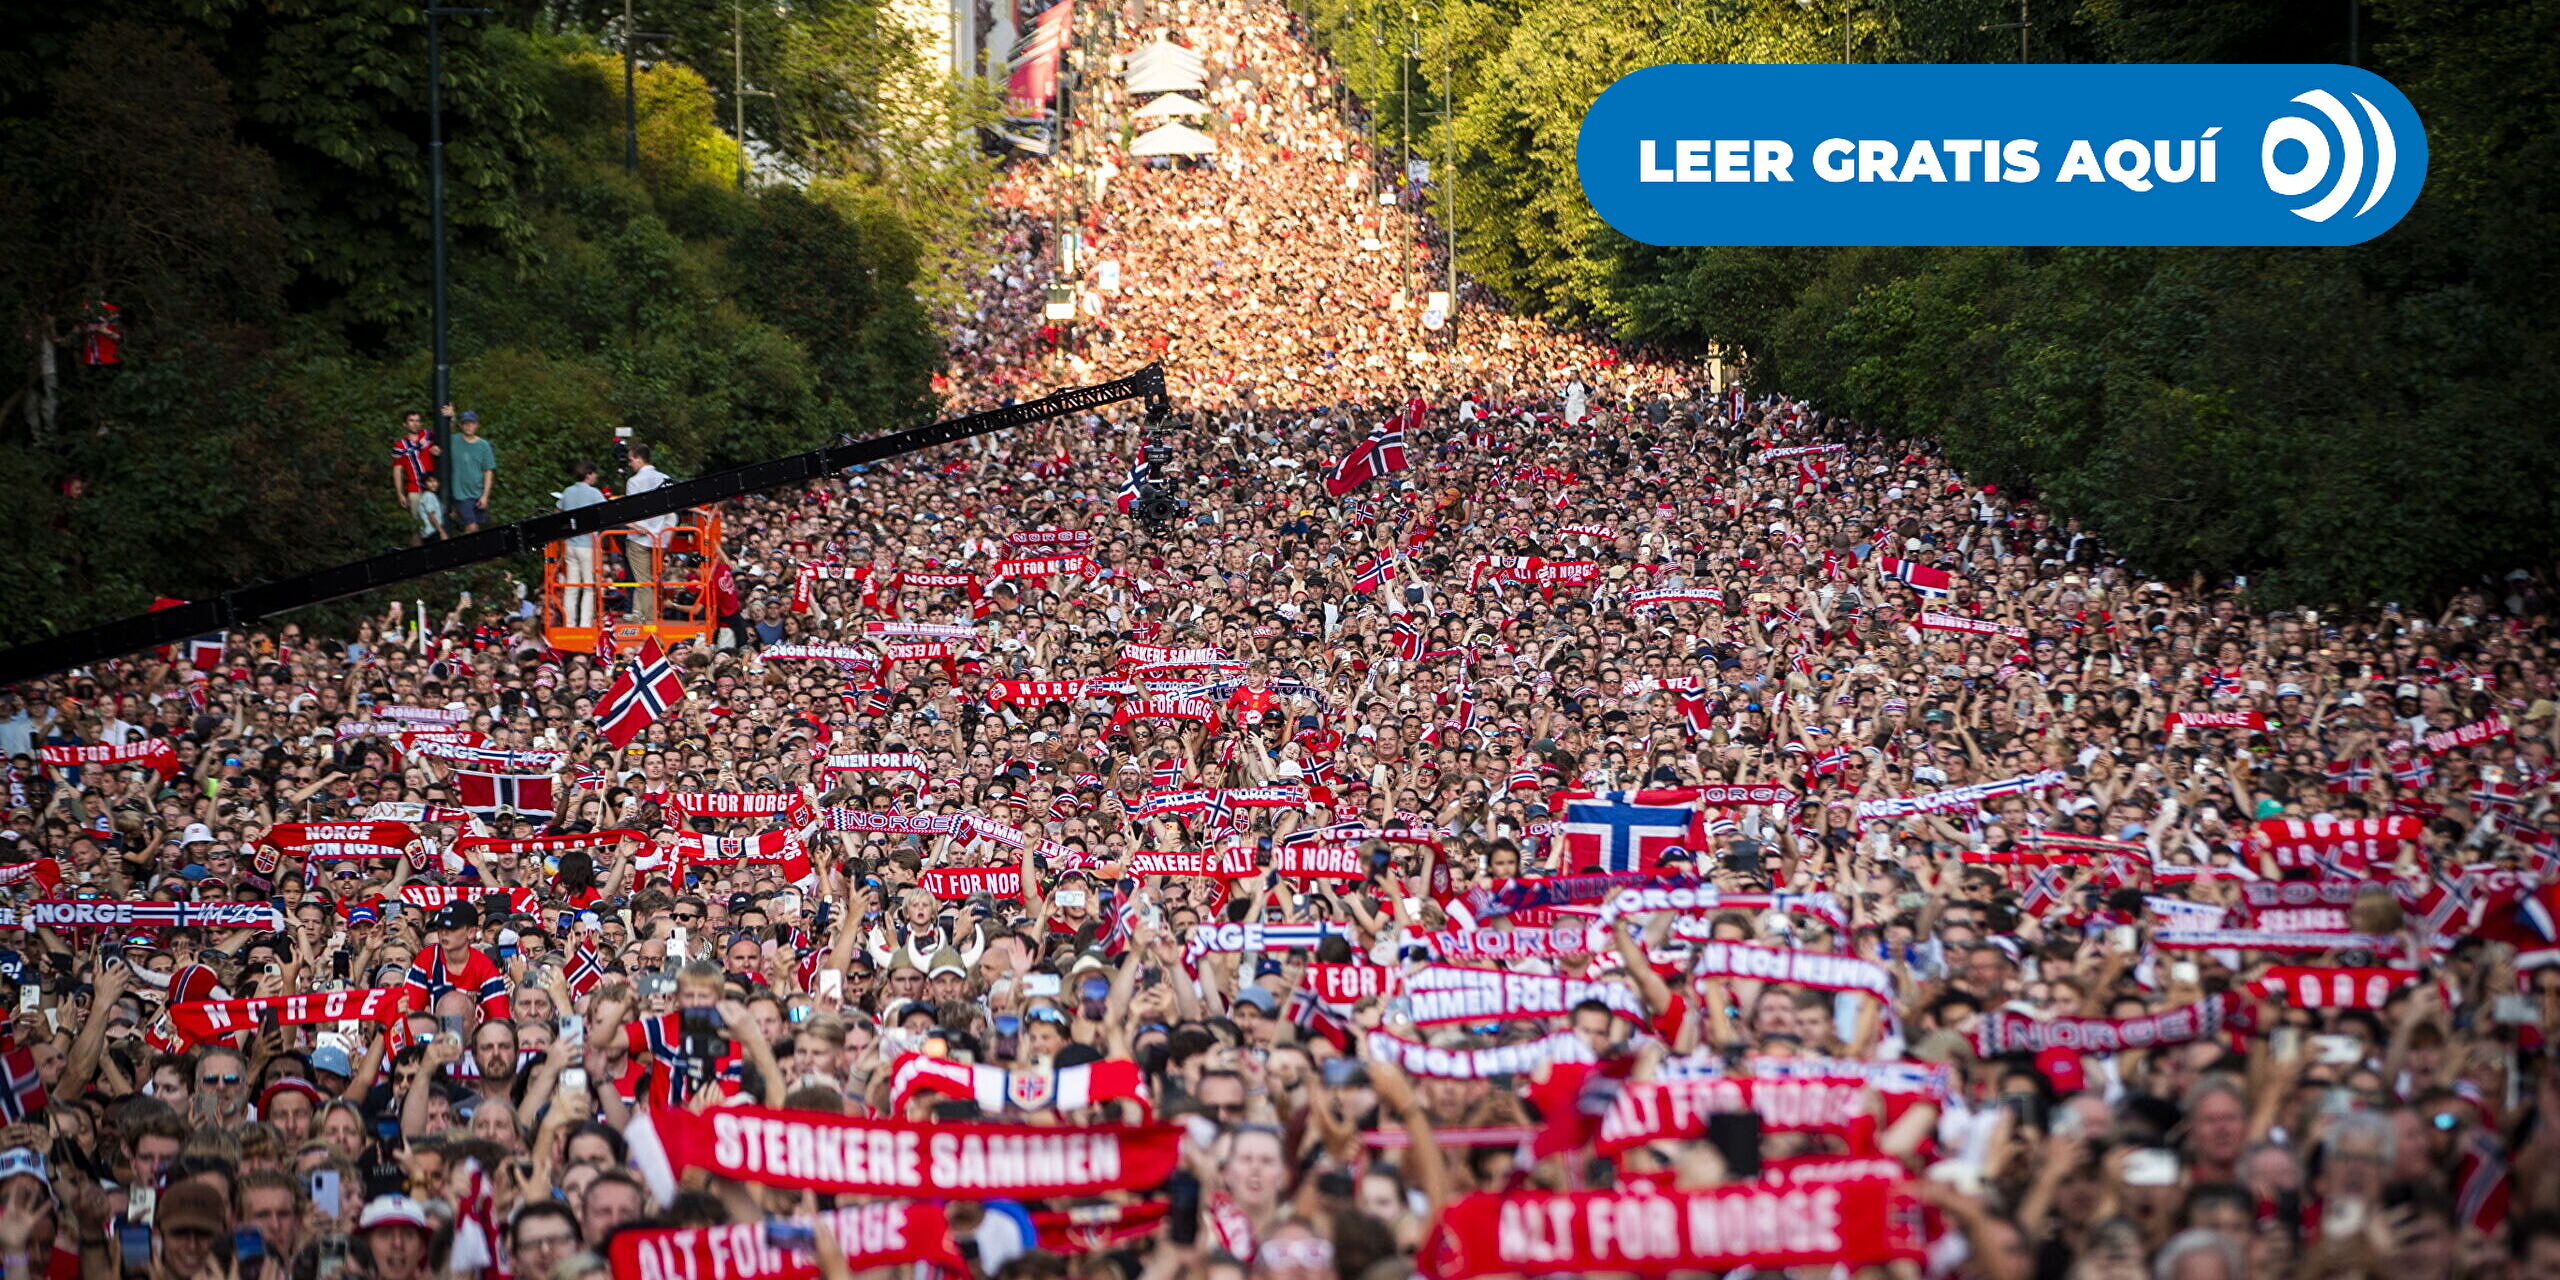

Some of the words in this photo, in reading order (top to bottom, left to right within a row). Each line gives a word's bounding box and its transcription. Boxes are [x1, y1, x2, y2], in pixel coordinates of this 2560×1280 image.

[1013, 531, 1088, 543] NORGE
[1002, 562, 1021, 577] ALT
[1023, 561, 1044, 575] FOR
[903, 575, 968, 585] NORGE
[1121, 644, 1167, 663] ERKERE
[1019, 682, 1080, 696] NORG
[1126, 700, 1145, 717] ALT
[1149, 699, 1176, 714] FOR
[2180, 712, 2249, 728] NORGE
[42, 744, 74, 763] ALT
[77, 744, 112, 763] FOR
[871, 755, 899, 768] FOR
[708, 793, 738, 812] FOR
[743, 793, 798, 812] NORGE
[848, 813, 950, 831] NORGE
[305, 825, 373, 840] NORGE
[1222, 851, 1253, 872] ALT
[1273, 848, 1297, 872] OR
[949, 873, 982, 896] FOR
[986, 871, 1020, 894] NOR
[36, 903, 132, 924] NORGE
[1438, 929, 1581, 954] NORG
[1326, 966, 1379, 999] FOR
[714, 1113, 922, 1188] STERKERE
[930, 1131, 1121, 1189] SAMMEN
[1499, 1198, 1576, 1264] ALT
[1586, 1196, 1680, 1262] FOR
[1688, 1187, 1843, 1257] NORGE
